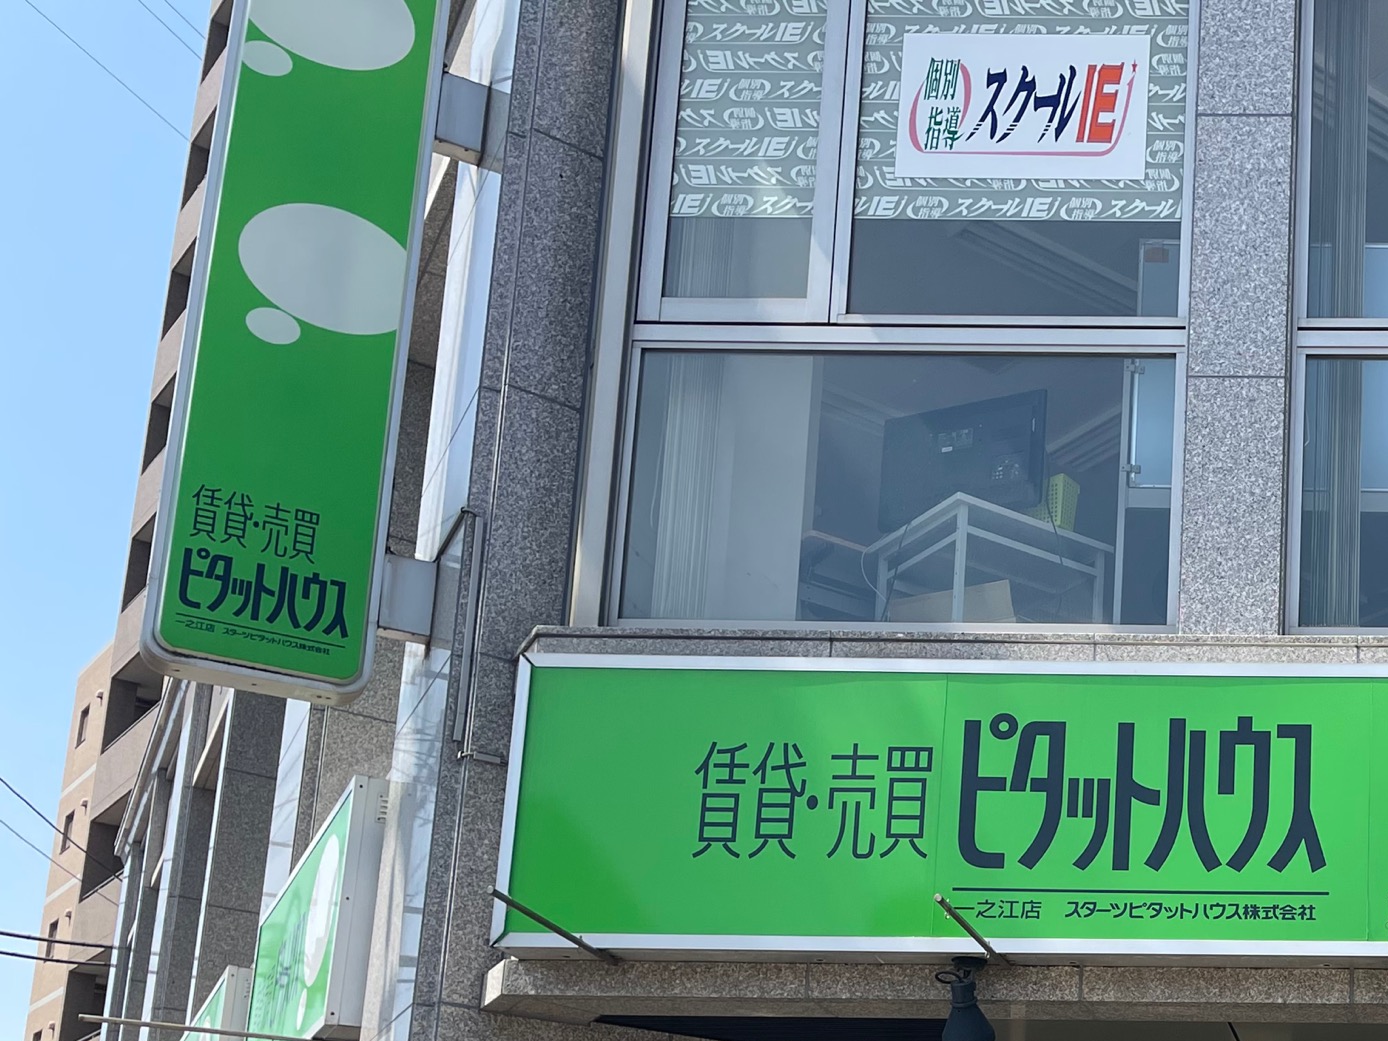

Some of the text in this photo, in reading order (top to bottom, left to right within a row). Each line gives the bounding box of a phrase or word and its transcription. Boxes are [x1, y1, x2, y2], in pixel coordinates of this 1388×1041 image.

[923, 57, 961, 100] 個別
[965, 62, 1124, 144] スクールIE
[924, 107, 965, 150] 指導
[948, 197, 1052, 216] スクールIE
[190, 484, 320, 564] 賃貸・売買
[178, 547, 349, 638] ピタットハウス
[175, 619, 216, 633] 一之江店
[692, 713, 1326, 872] 賃貸・売買 ピタットハウス
[953, 899, 1316, 921] 一之江店 スターツピタットハウス株式会社
